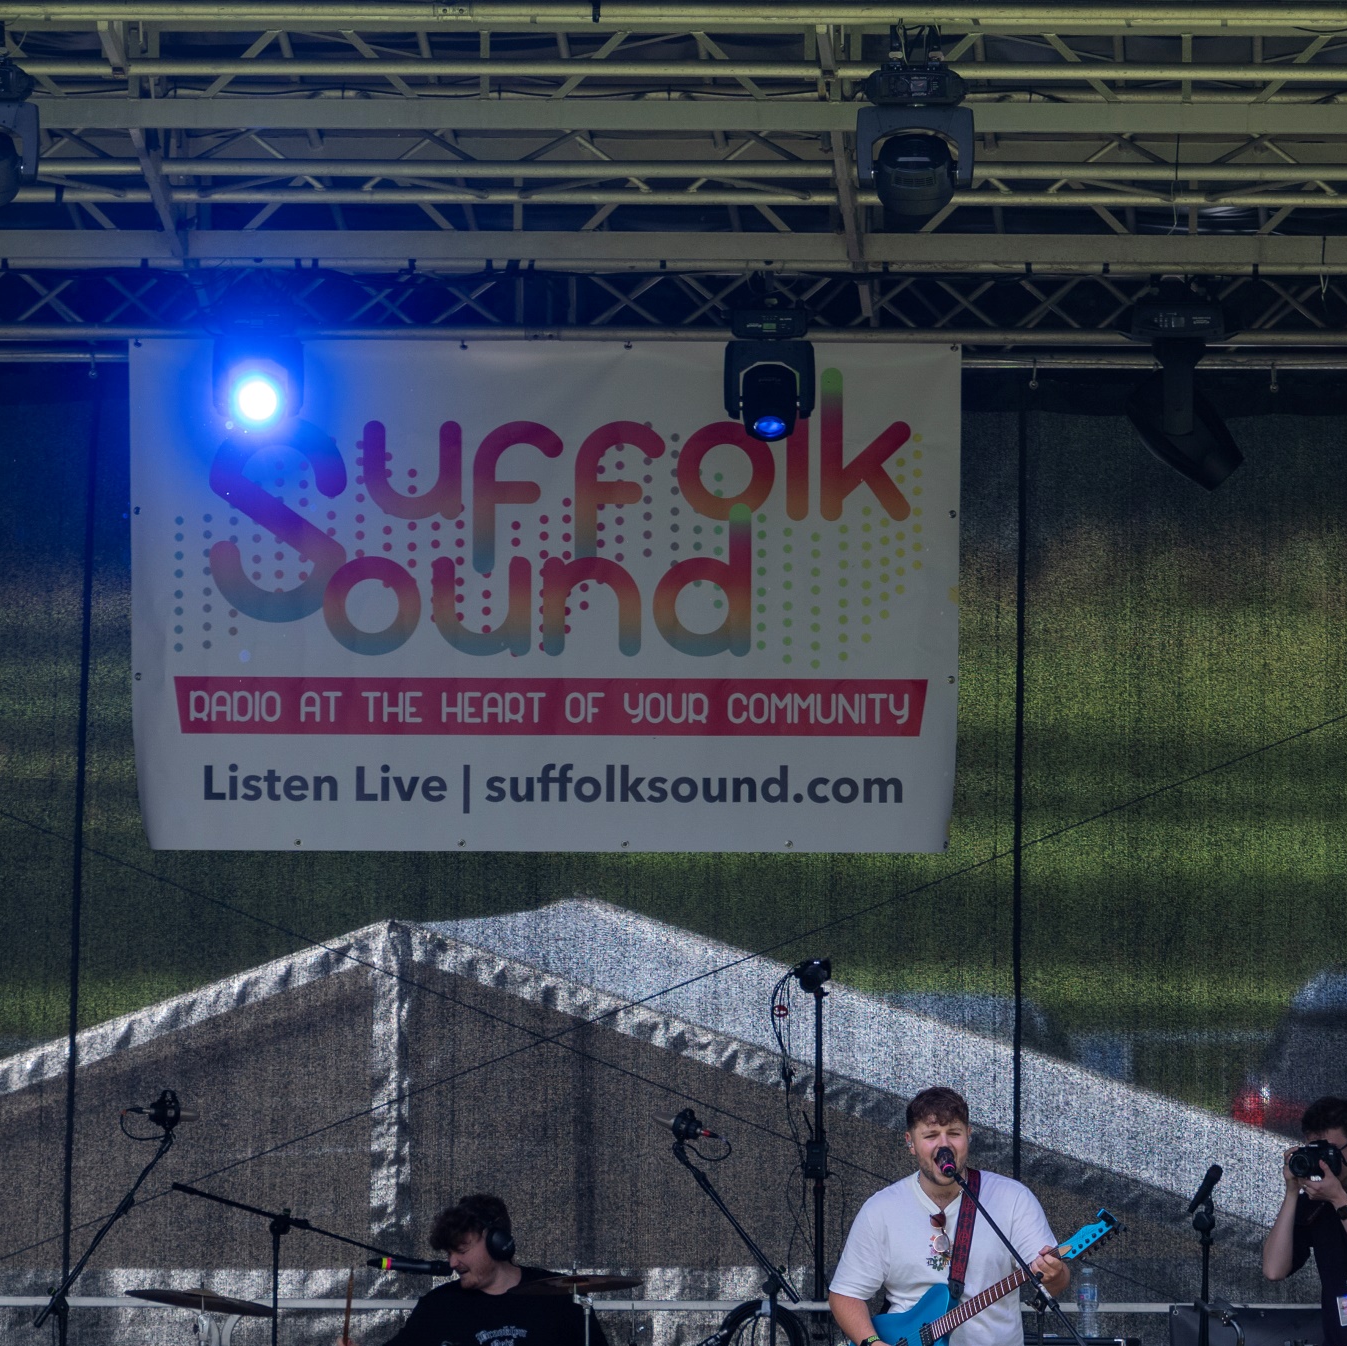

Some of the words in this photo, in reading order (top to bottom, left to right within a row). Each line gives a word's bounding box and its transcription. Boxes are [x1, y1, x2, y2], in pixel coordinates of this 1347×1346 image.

[208, 367, 913, 623] Suffolk
[187, 690, 282, 725] RADIO
[299, 691, 340, 724] AT
[361, 691, 423, 724] THE
[441, 691, 547, 724] HEART
[564, 691, 606, 725] OF
[623, 691, 709, 725] YOUR
[726, 692, 911, 726] COMMUNITY
[202, 765, 341, 803] Listen
[356, 765, 449, 803] Live
[485, 763, 904, 805] suffolksound.com
